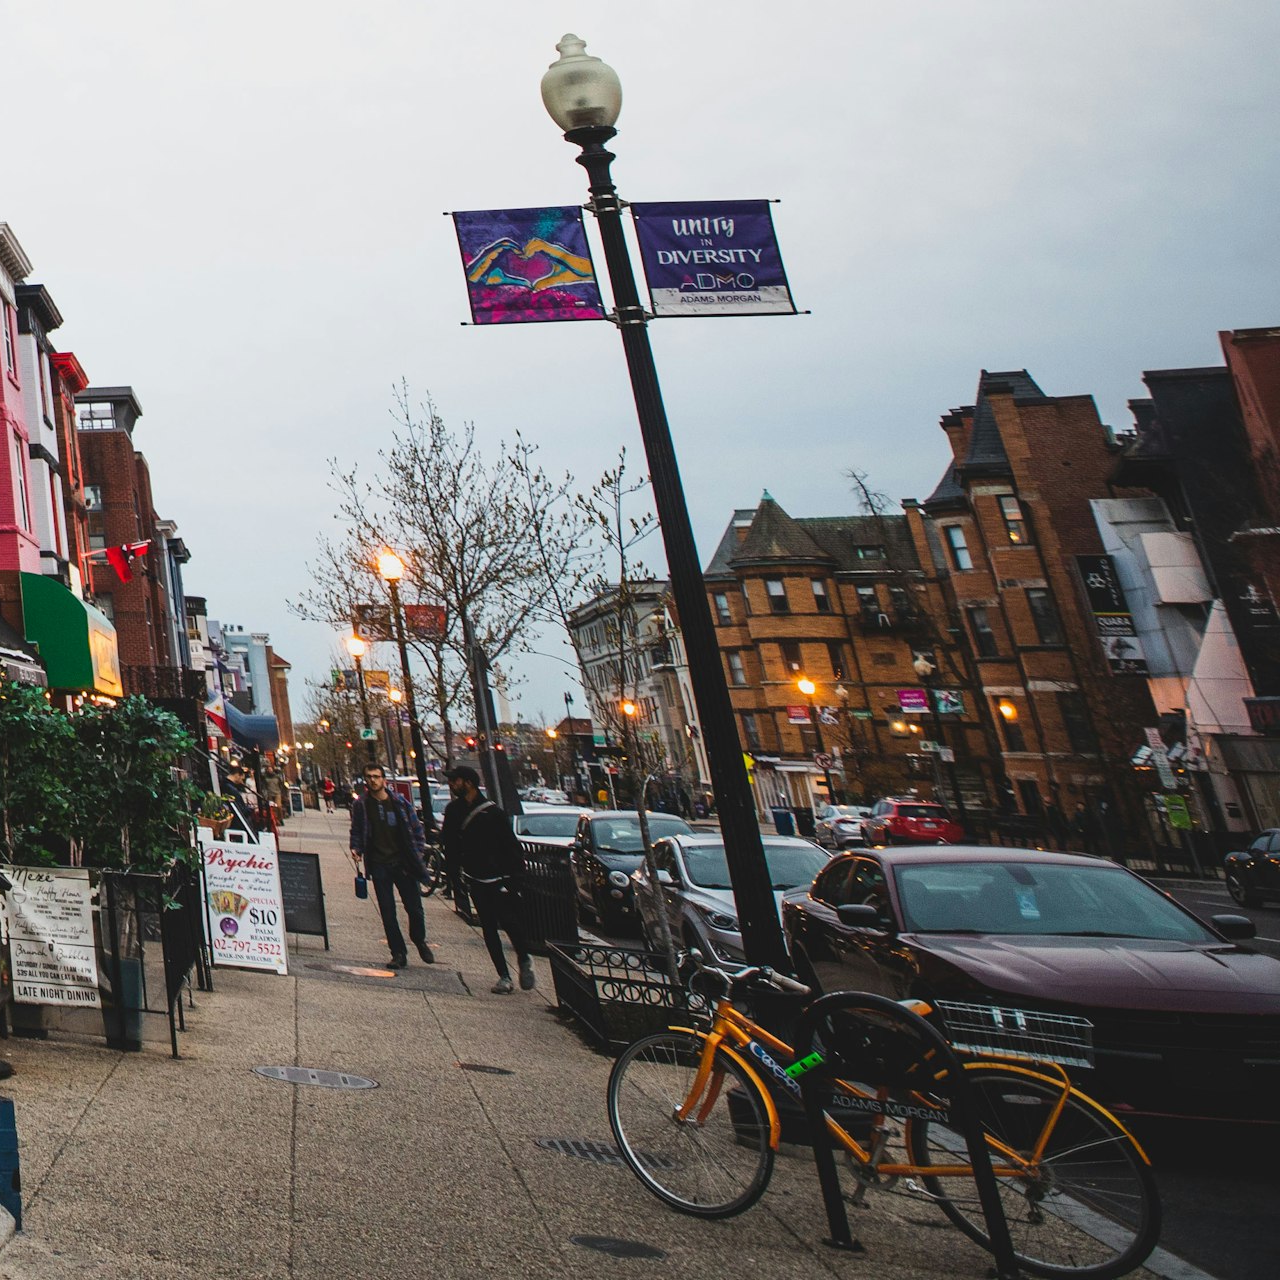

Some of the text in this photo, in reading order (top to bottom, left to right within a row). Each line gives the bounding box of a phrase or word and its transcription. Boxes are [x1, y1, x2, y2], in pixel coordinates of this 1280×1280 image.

[657, 249, 762, 264] DIVERSITY
[681, 273, 755, 289] ADMO
[680, 295, 761, 303] ADAMS MORGAN
[204, 847, 274, 872] Psychic
[250, 897, 278, 905] SPECIAL
[250, 907, 277, 926] $10
[250, 934, 280, 942] READING
[16, 943, 90, 961] Brunch Bubbles
[214, 939, 281, 955] 02-797-5522
[17, 961, 38, 969] SATURDAY
[43, 963, 58, 971] SUNDAY
[18, 986, 96, 1001] LATE NIGHT DINING
[832, 1095, 949, 1123] ADAMS MORGAN
